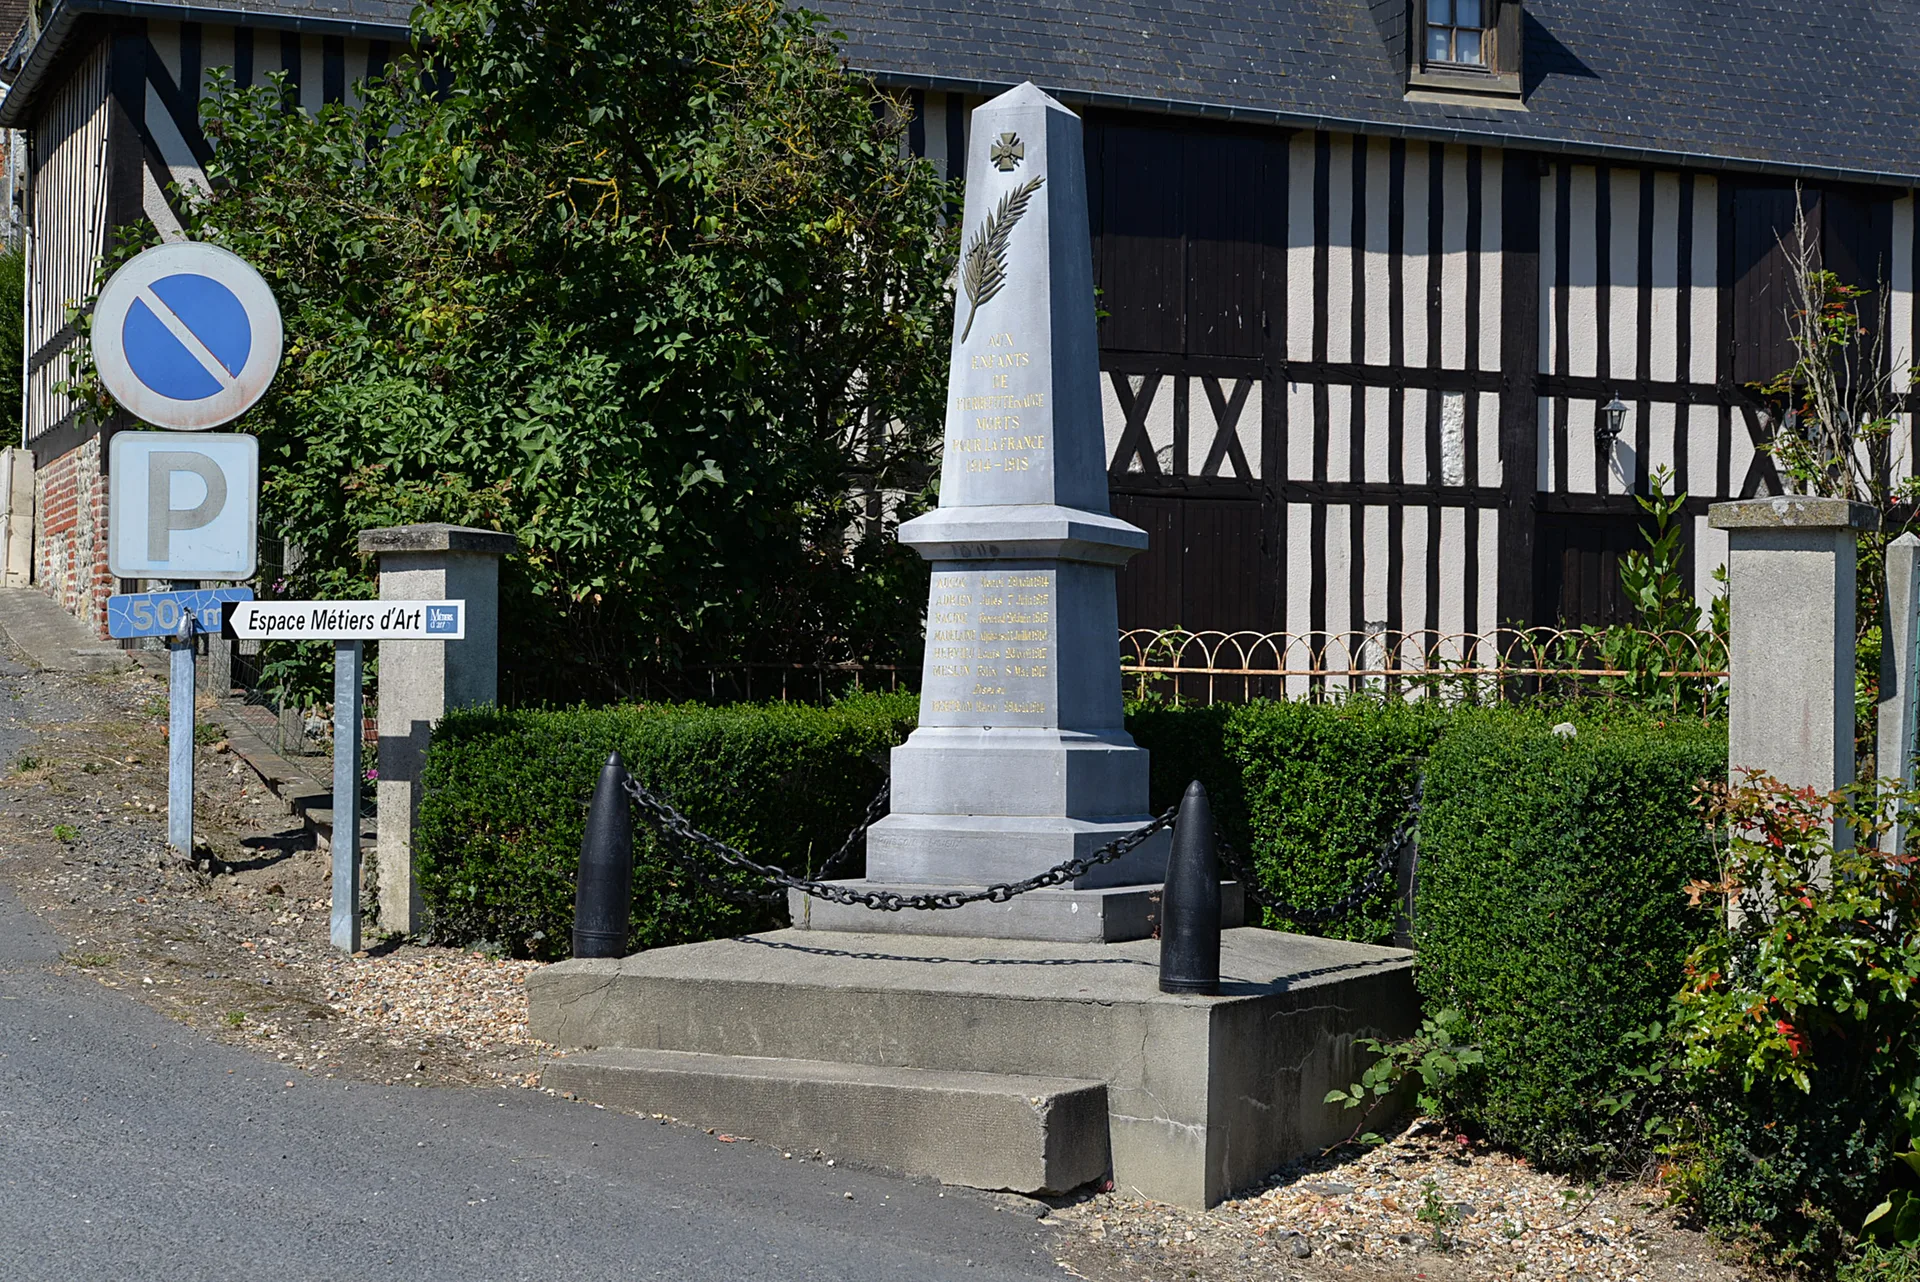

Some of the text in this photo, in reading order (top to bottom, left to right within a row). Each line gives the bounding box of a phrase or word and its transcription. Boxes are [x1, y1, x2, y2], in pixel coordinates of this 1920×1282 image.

[988, 332, 1014, 347] AUX
[971, 352, 1030, 370] ENFANTS
[992, 374, 1009, 389] DE
[976, 415, 1021, 432] MORTS
[952, 435, 1045, 453] POUR LA FRANCE
[148, 451, 227, 561] P
[936, 594, 972, 606] ADRIEN
[979, 593, 1003, 606] Jules
[133, 599, 180, 631] 50
[248, 608, 421, 631] Espace Métiers d'Art
[977, 647, 1001, 659] Louis
[932, 665, 970, 677] MESLIN
